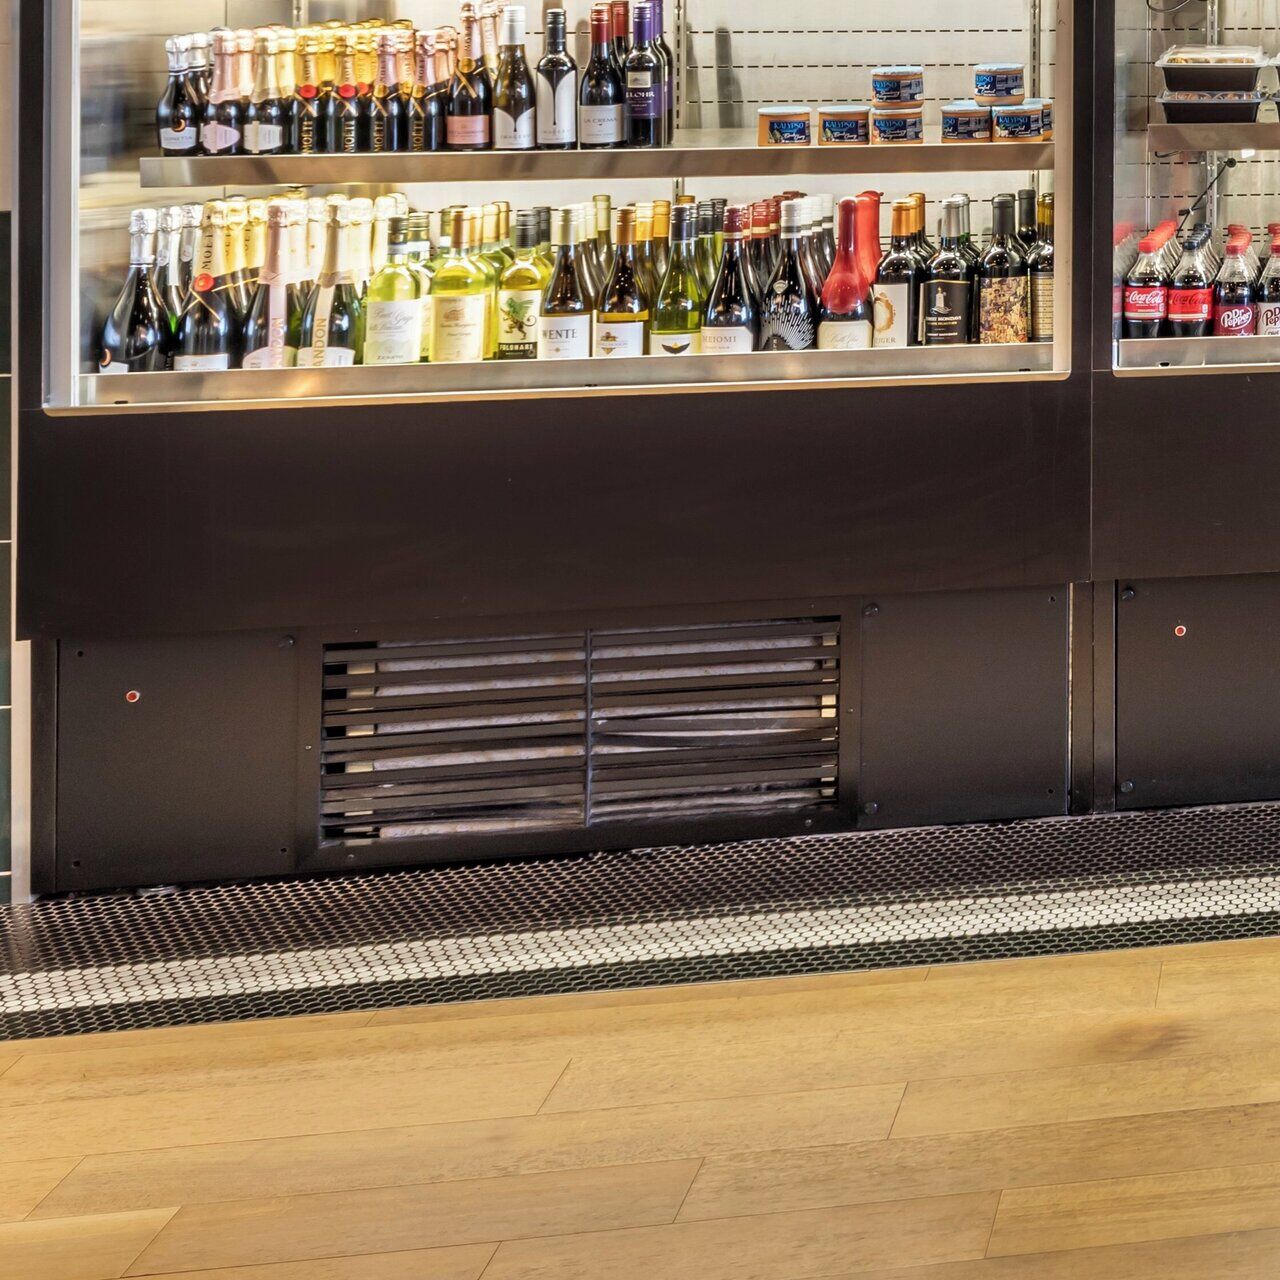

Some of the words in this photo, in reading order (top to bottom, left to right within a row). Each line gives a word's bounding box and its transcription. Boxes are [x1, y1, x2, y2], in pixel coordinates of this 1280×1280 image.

[1129, 290, 1165, 304] Coca-Cola
[1231, 306, 1246, 319] Dr
[1221, 312, 1251, 329] Pepper
[542, 328, 578, 340] WENTE
